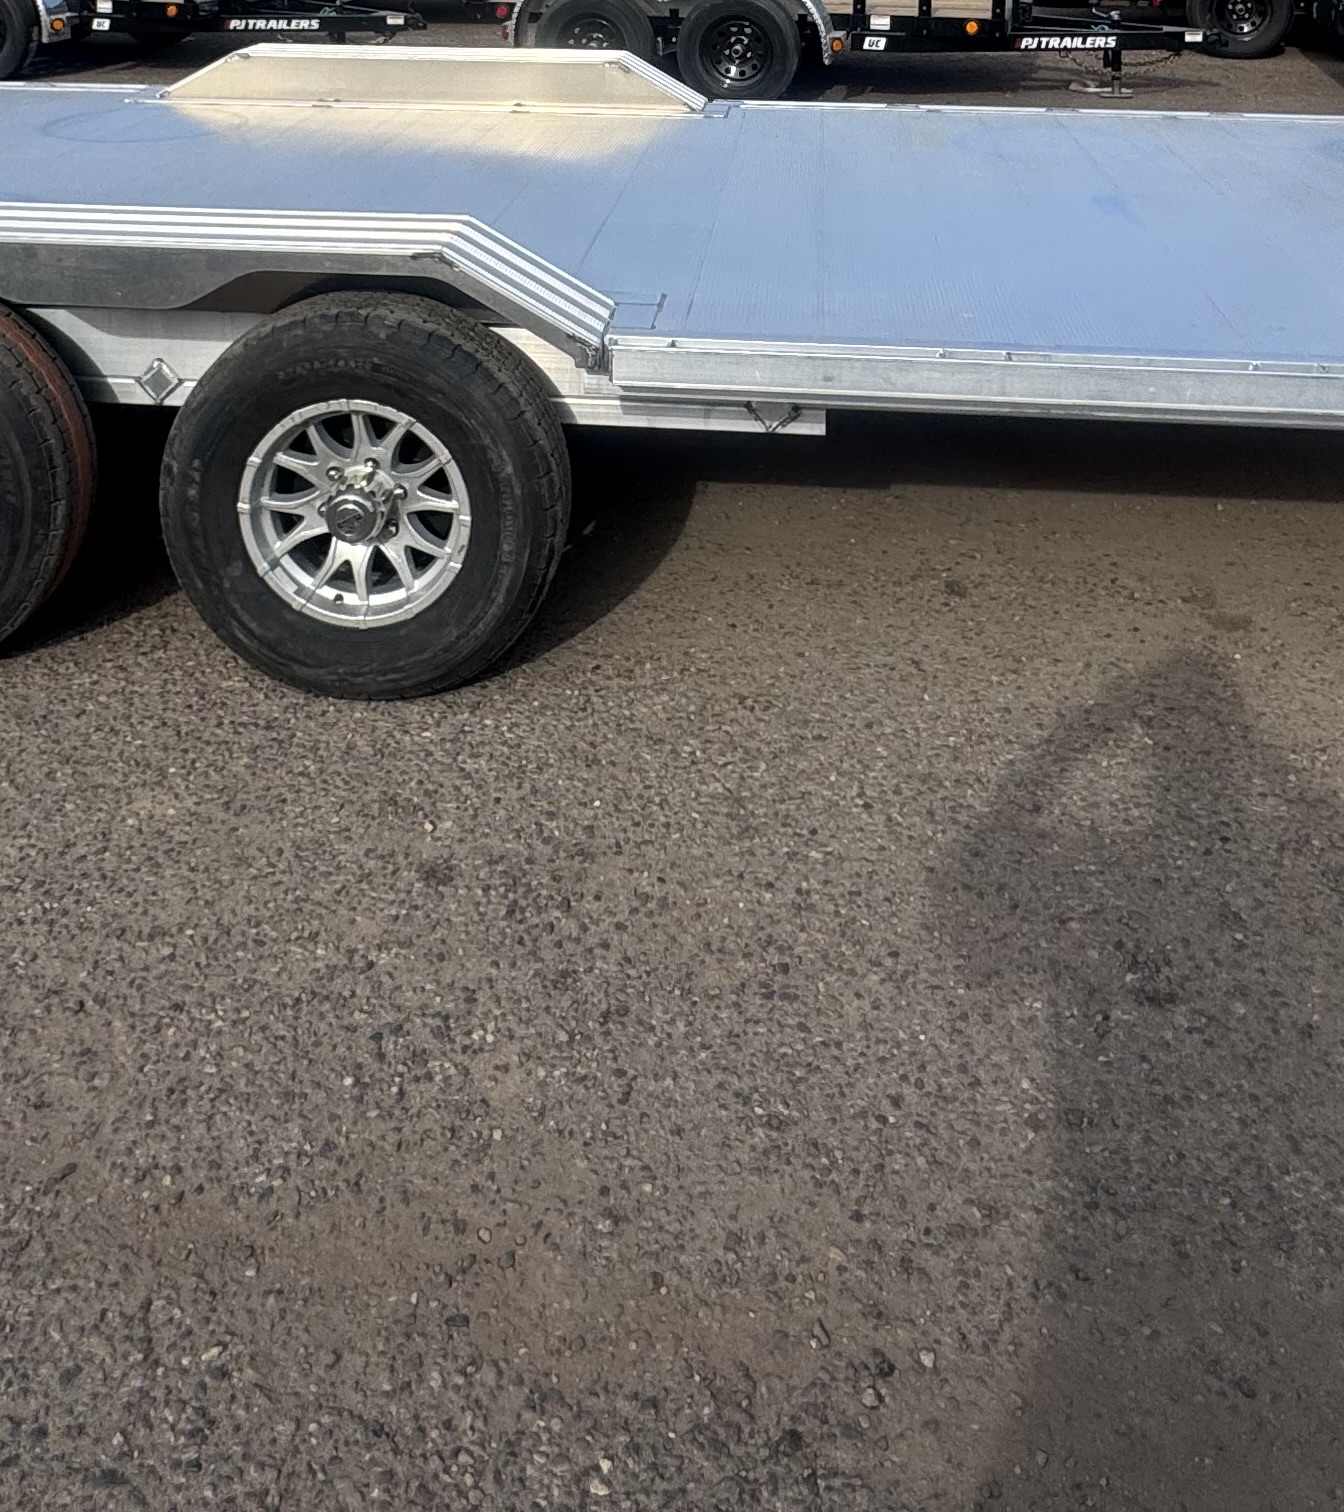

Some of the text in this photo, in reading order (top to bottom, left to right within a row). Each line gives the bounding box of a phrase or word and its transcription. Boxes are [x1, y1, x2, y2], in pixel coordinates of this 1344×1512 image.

[230, 19, 320, 30] PJ TRAILERS
[1020, 36, 1117, 49] PJ TRAILERS
